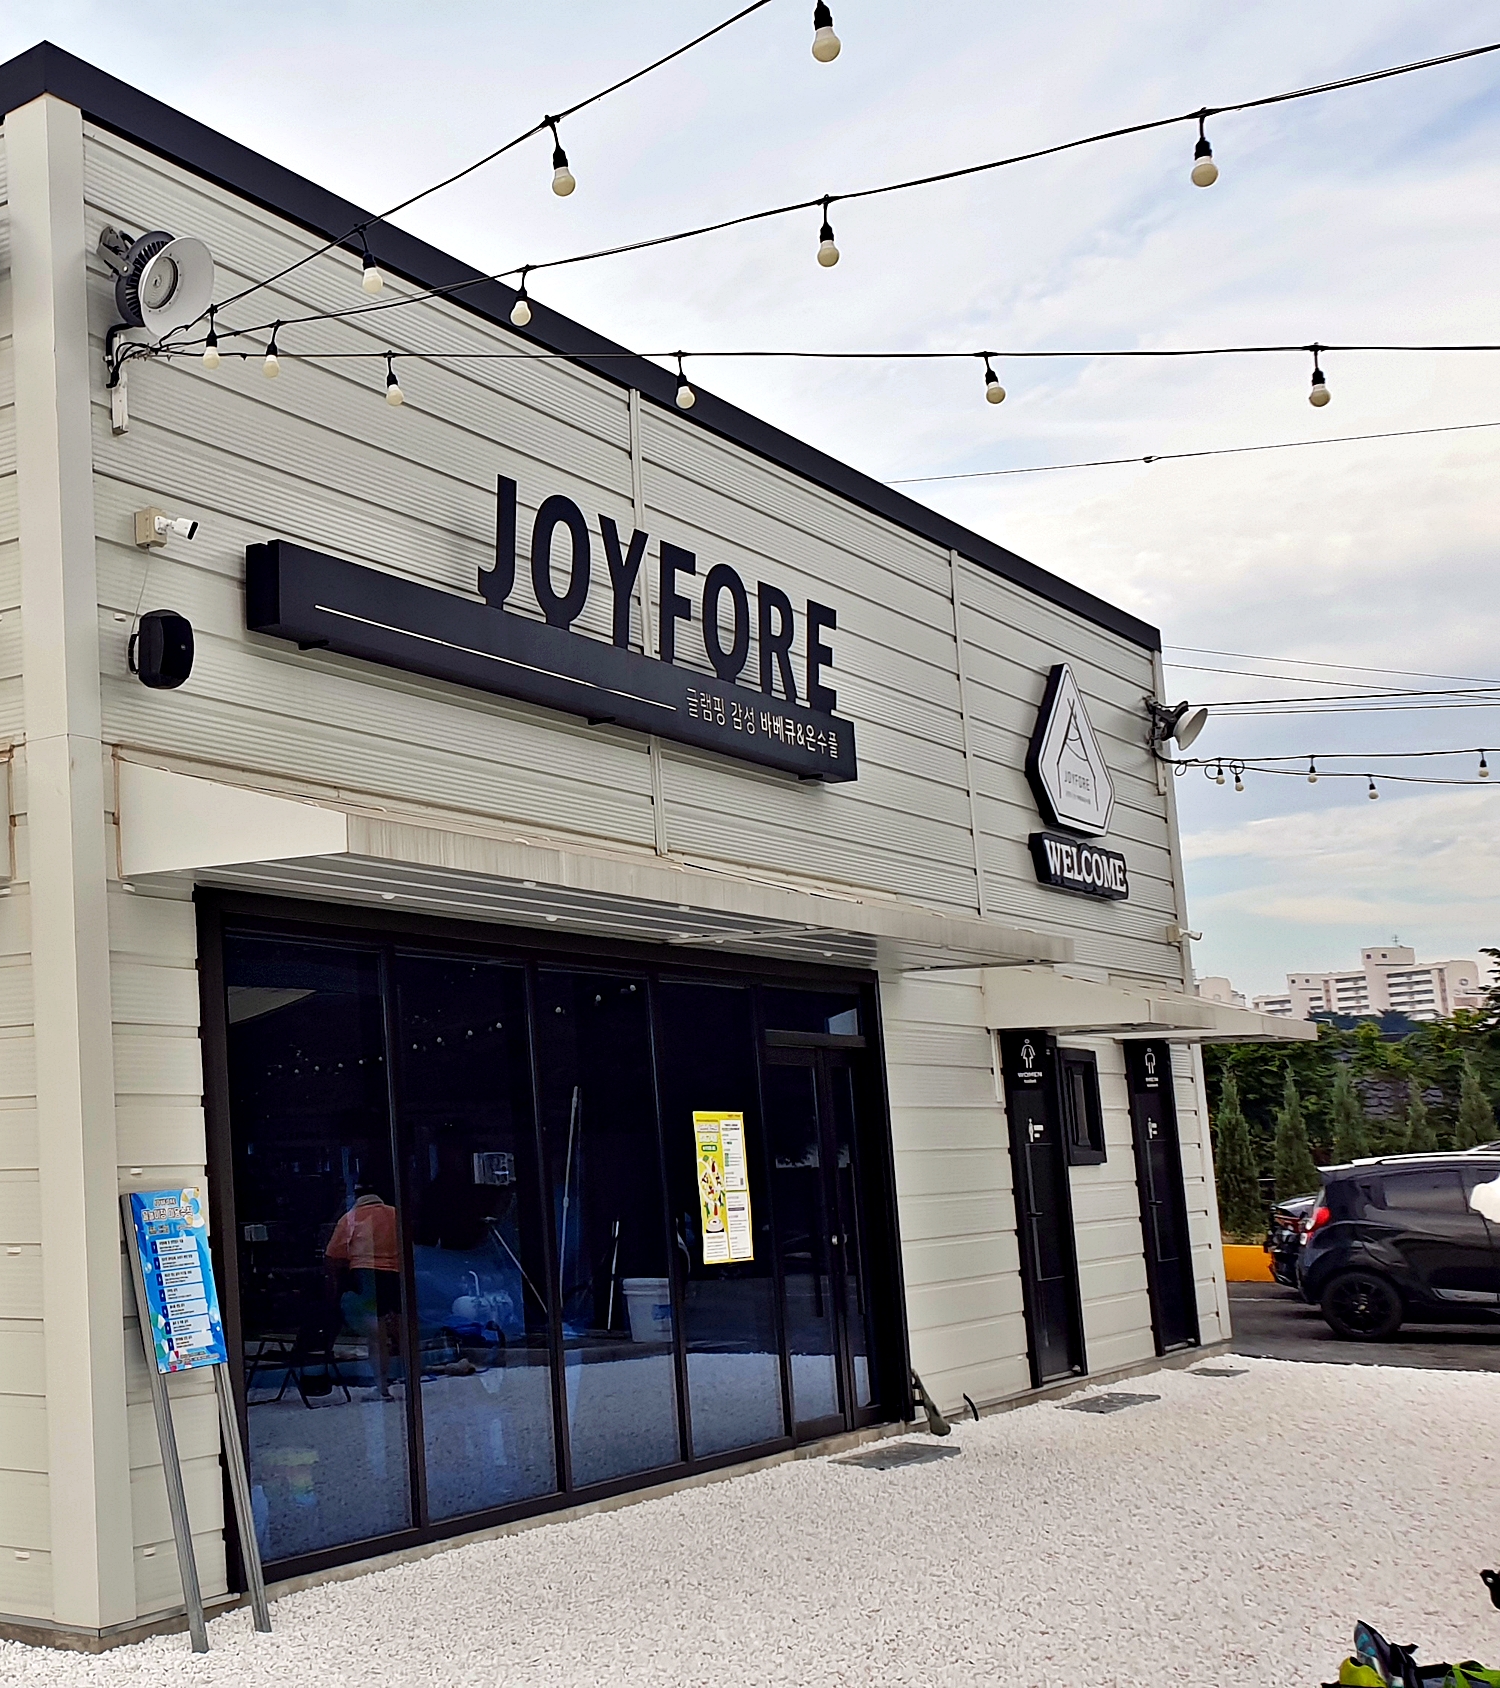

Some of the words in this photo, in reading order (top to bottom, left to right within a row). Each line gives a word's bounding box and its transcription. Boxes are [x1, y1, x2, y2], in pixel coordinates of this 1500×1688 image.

[478, 474, 838, 710] JOYFORE
[686, 687, 726, 726] 글램핑
[730, 702, 756, 735] 감성
[760, 711, 839, 760] 바베큐&온수풀
[1044, 839, 1127, 893] WELCOME
